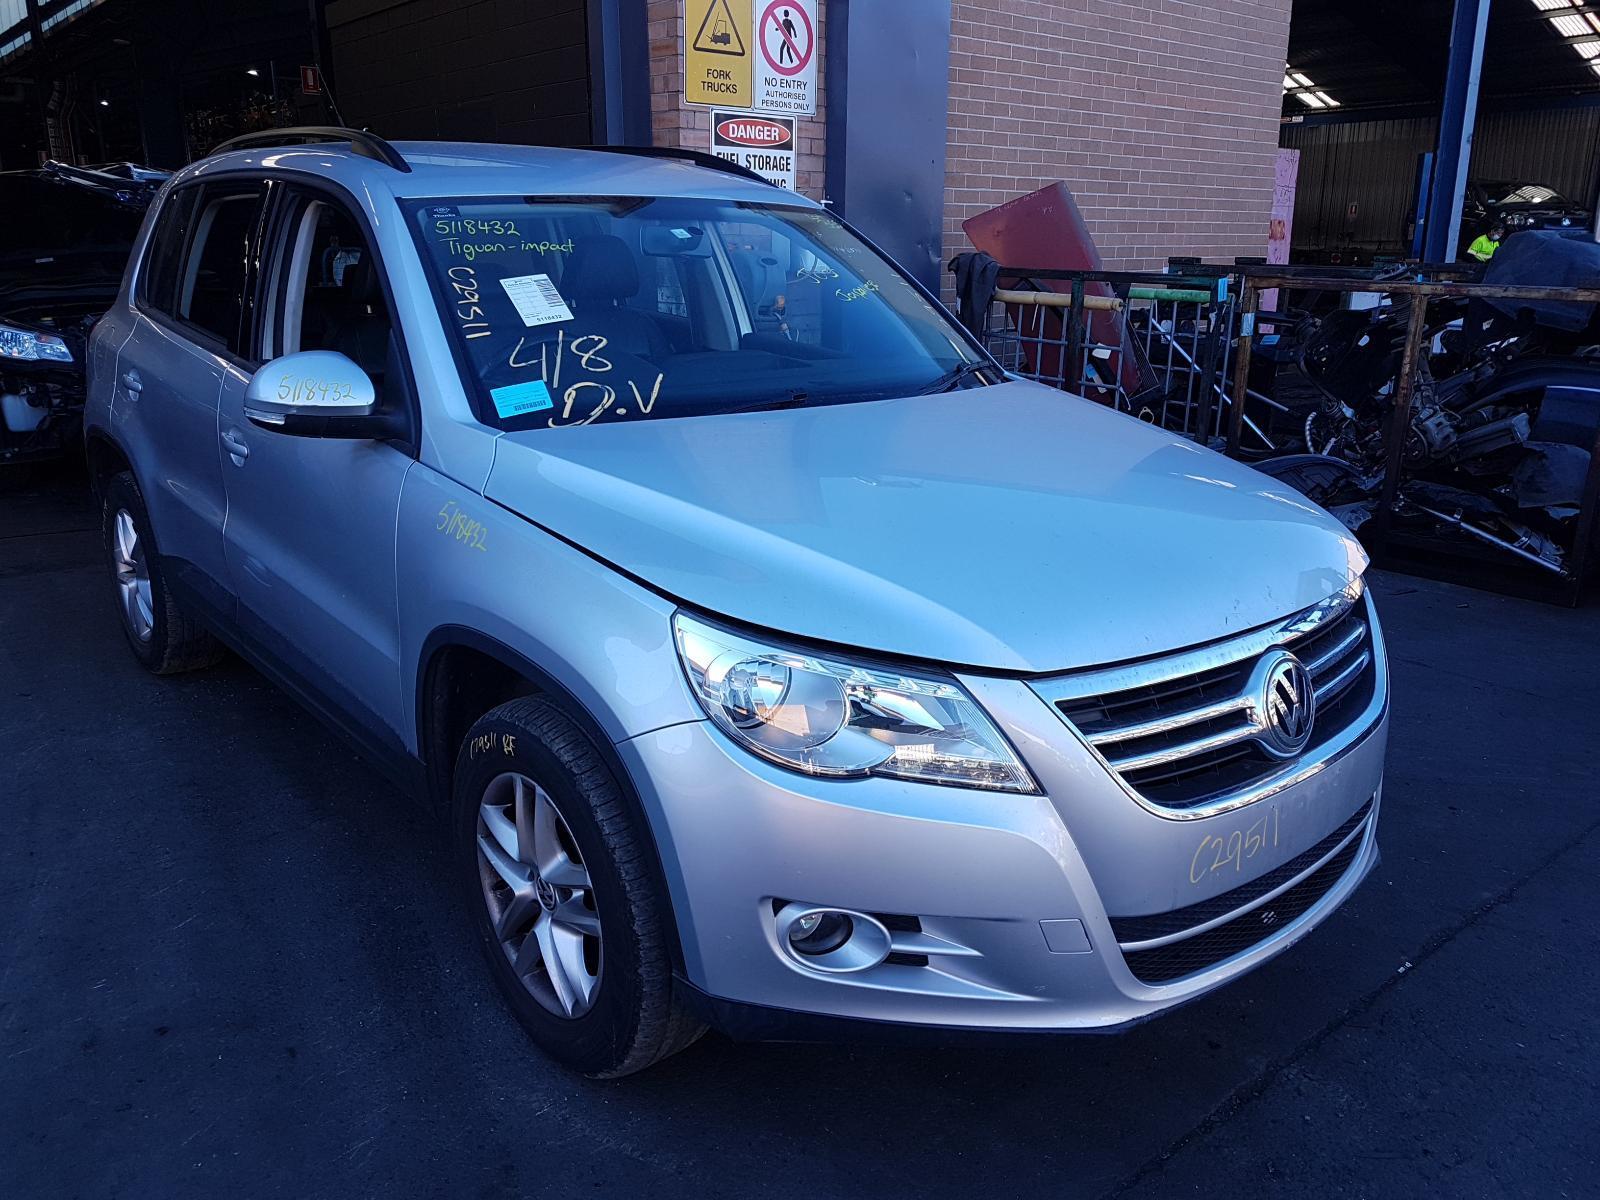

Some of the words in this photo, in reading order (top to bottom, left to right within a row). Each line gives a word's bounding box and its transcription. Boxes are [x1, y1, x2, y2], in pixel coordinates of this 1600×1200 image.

[706, 68, 731, 80] FORK
[701, 81, 737, 94] TRUCKS
[764, 77, 778, 87] NO
[779, 78, 807, 91] ENTRY
[765, 90, 806, 101] AUTHORISED
[761, 99, 792, 109] PERSONS
[793, 101, 809, 111] ONLY
[728, 123, 780, 141] DANGER
[745, 153, 791, 172] STORAGE
[434, 220, 521, 236] 5118432
[277, 374, 357, 402] 5118432
[1189, 809, 1280, 884] C29511
